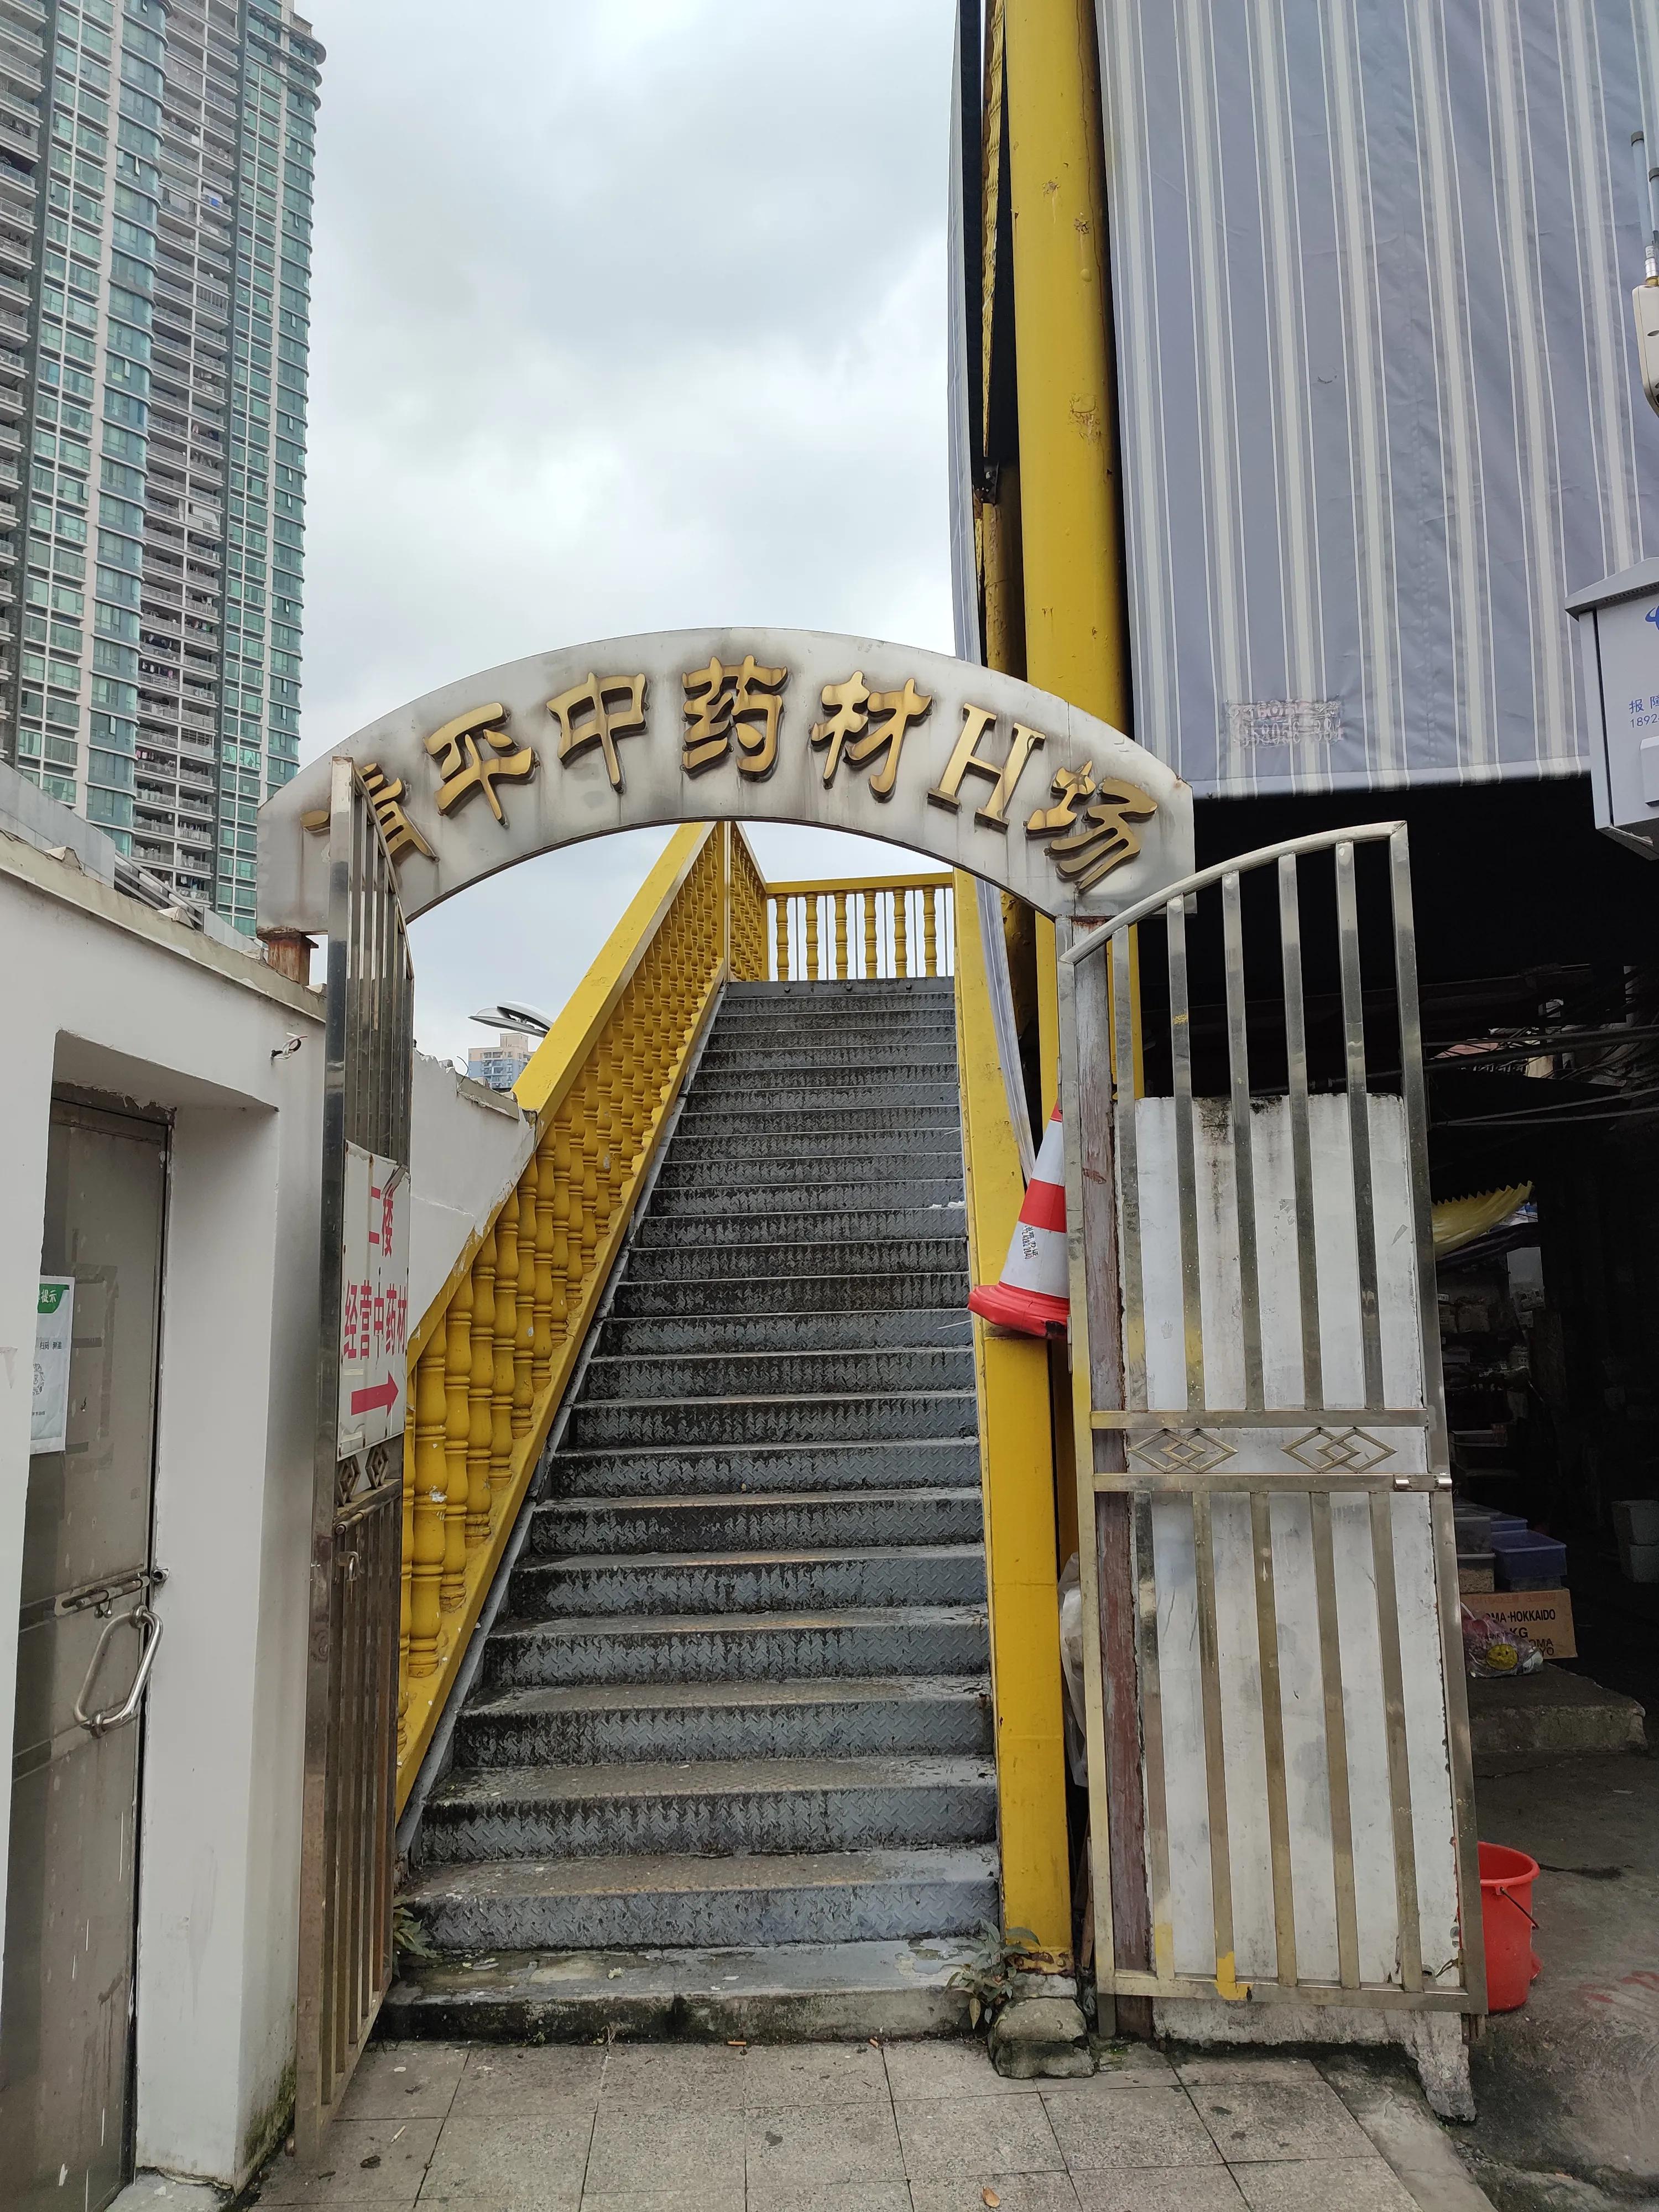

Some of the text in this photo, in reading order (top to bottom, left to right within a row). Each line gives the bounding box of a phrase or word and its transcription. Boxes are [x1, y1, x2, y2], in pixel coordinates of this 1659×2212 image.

[1630, 714, 1659, 728] 1892
[369, 1183, 393, 1258] 二楼
[39, 1289, 57, 1303] 提示
[343, 1279, 406, 1360] 经营中药材
